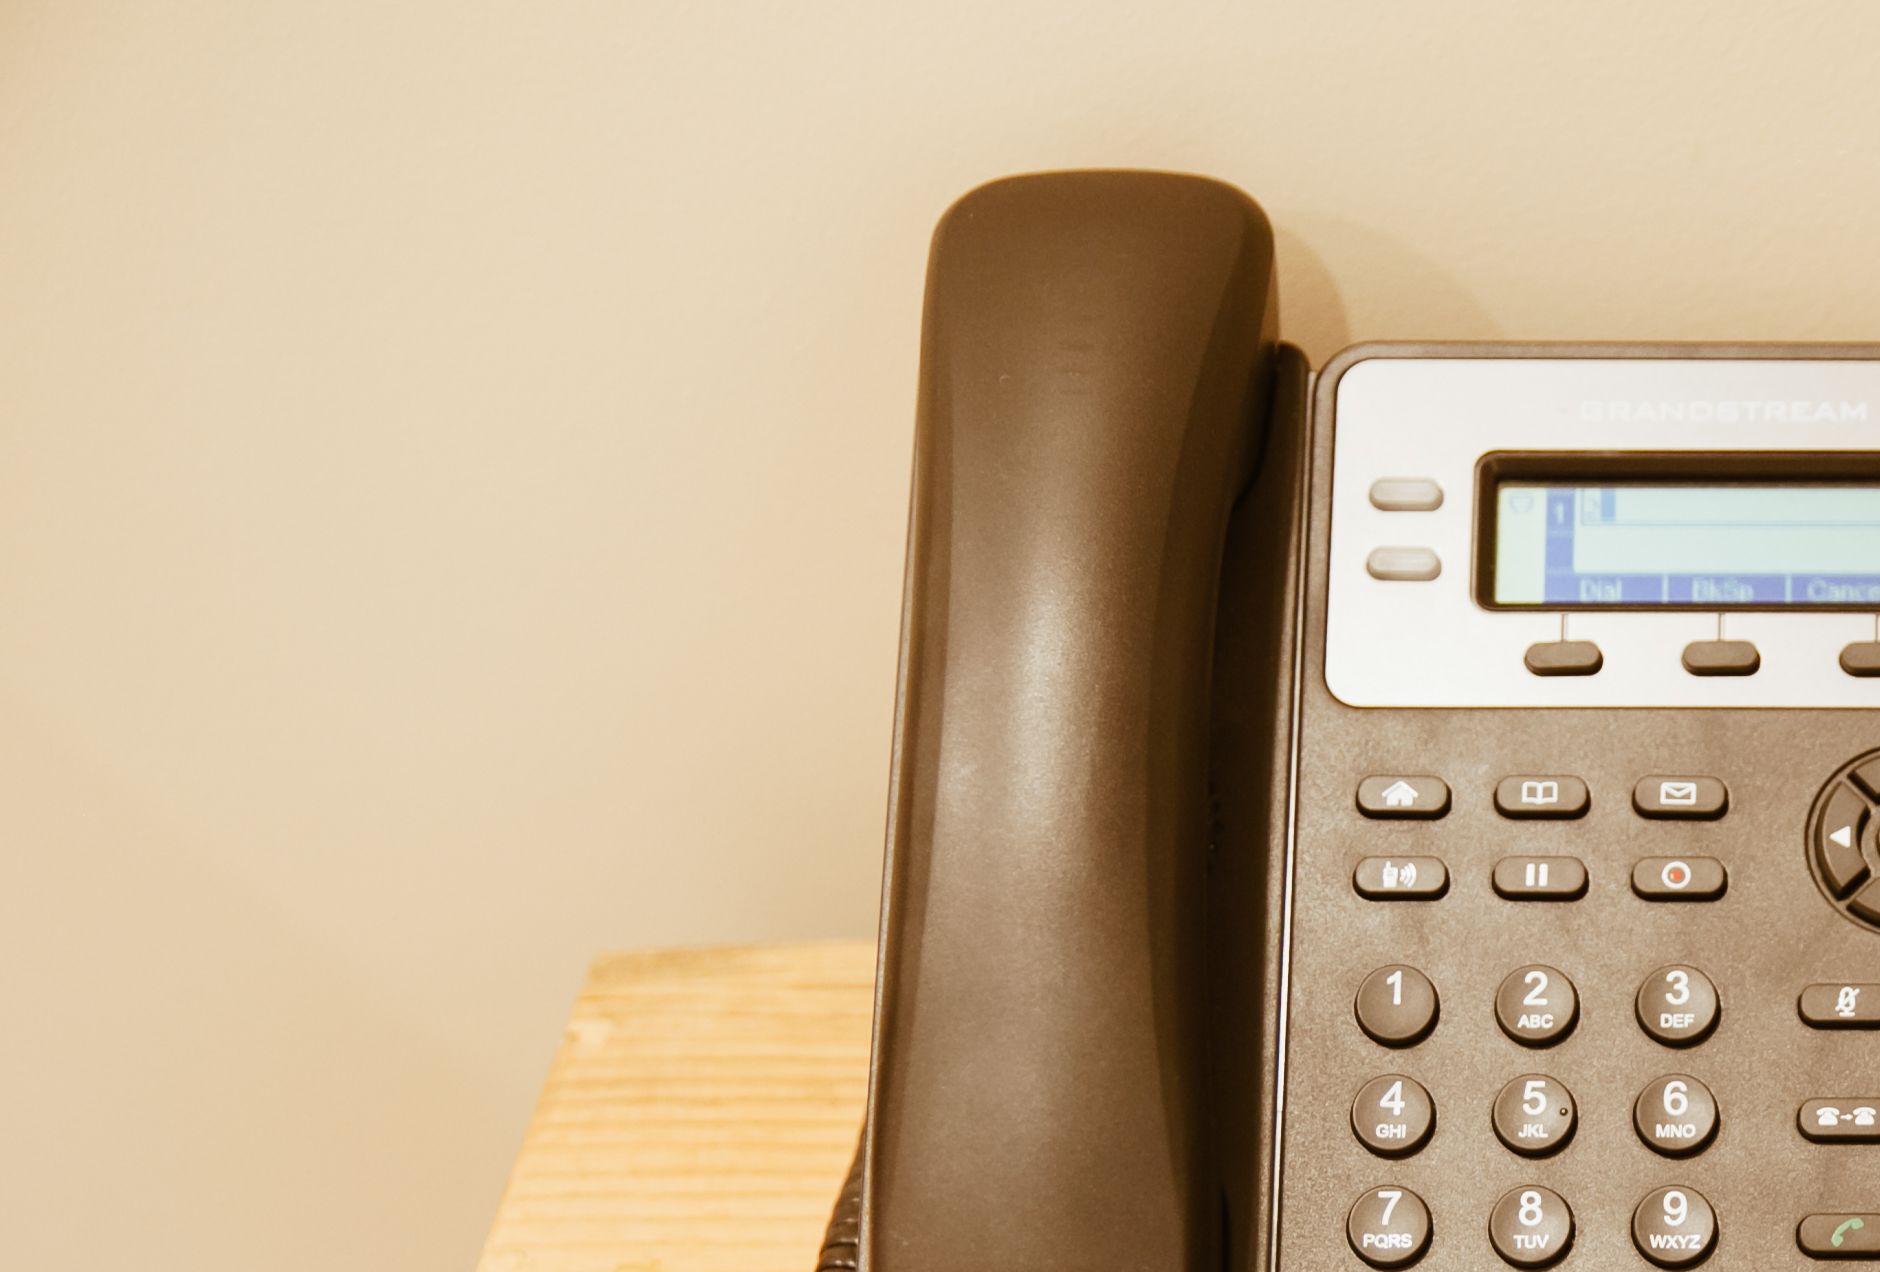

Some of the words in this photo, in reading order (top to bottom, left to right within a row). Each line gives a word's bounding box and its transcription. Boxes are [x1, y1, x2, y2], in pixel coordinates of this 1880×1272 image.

[1579, 400, 1868, 423] GRANDSTREAM
[1580, 578, 1622, 602] Dial
[1386, 970, 1402, 1006] 1
[1522, 970, 1548, 1005] 2
[1665, 970, 1690, 1005] 3
[1517, 1012, 1554, 1029] ABC
[1660, 1012, 1696, 1029] DEF
[1379, 1080, 1406, 1117] 4
[1522, 1080, 1546, 1116] 5
[1663, 1080, 1688, 1116] 6
[1375, 1123, 1407, 1139] GHI
[1518, 1123, 1549, 1139] JKL
[1655, 1123, 1697, 1139] MNO
[1377, 1190, 1402, 1226] 7
[1518, 1190, 1542, 1226] 8
[1663, 1190, 1688, 1226] 9
[1363, 1232, 1413, 1250] PQRS
[1513, 1233, 1549, 1250] TUV
[1649, 1233, 1701, 1250] WXYZ
